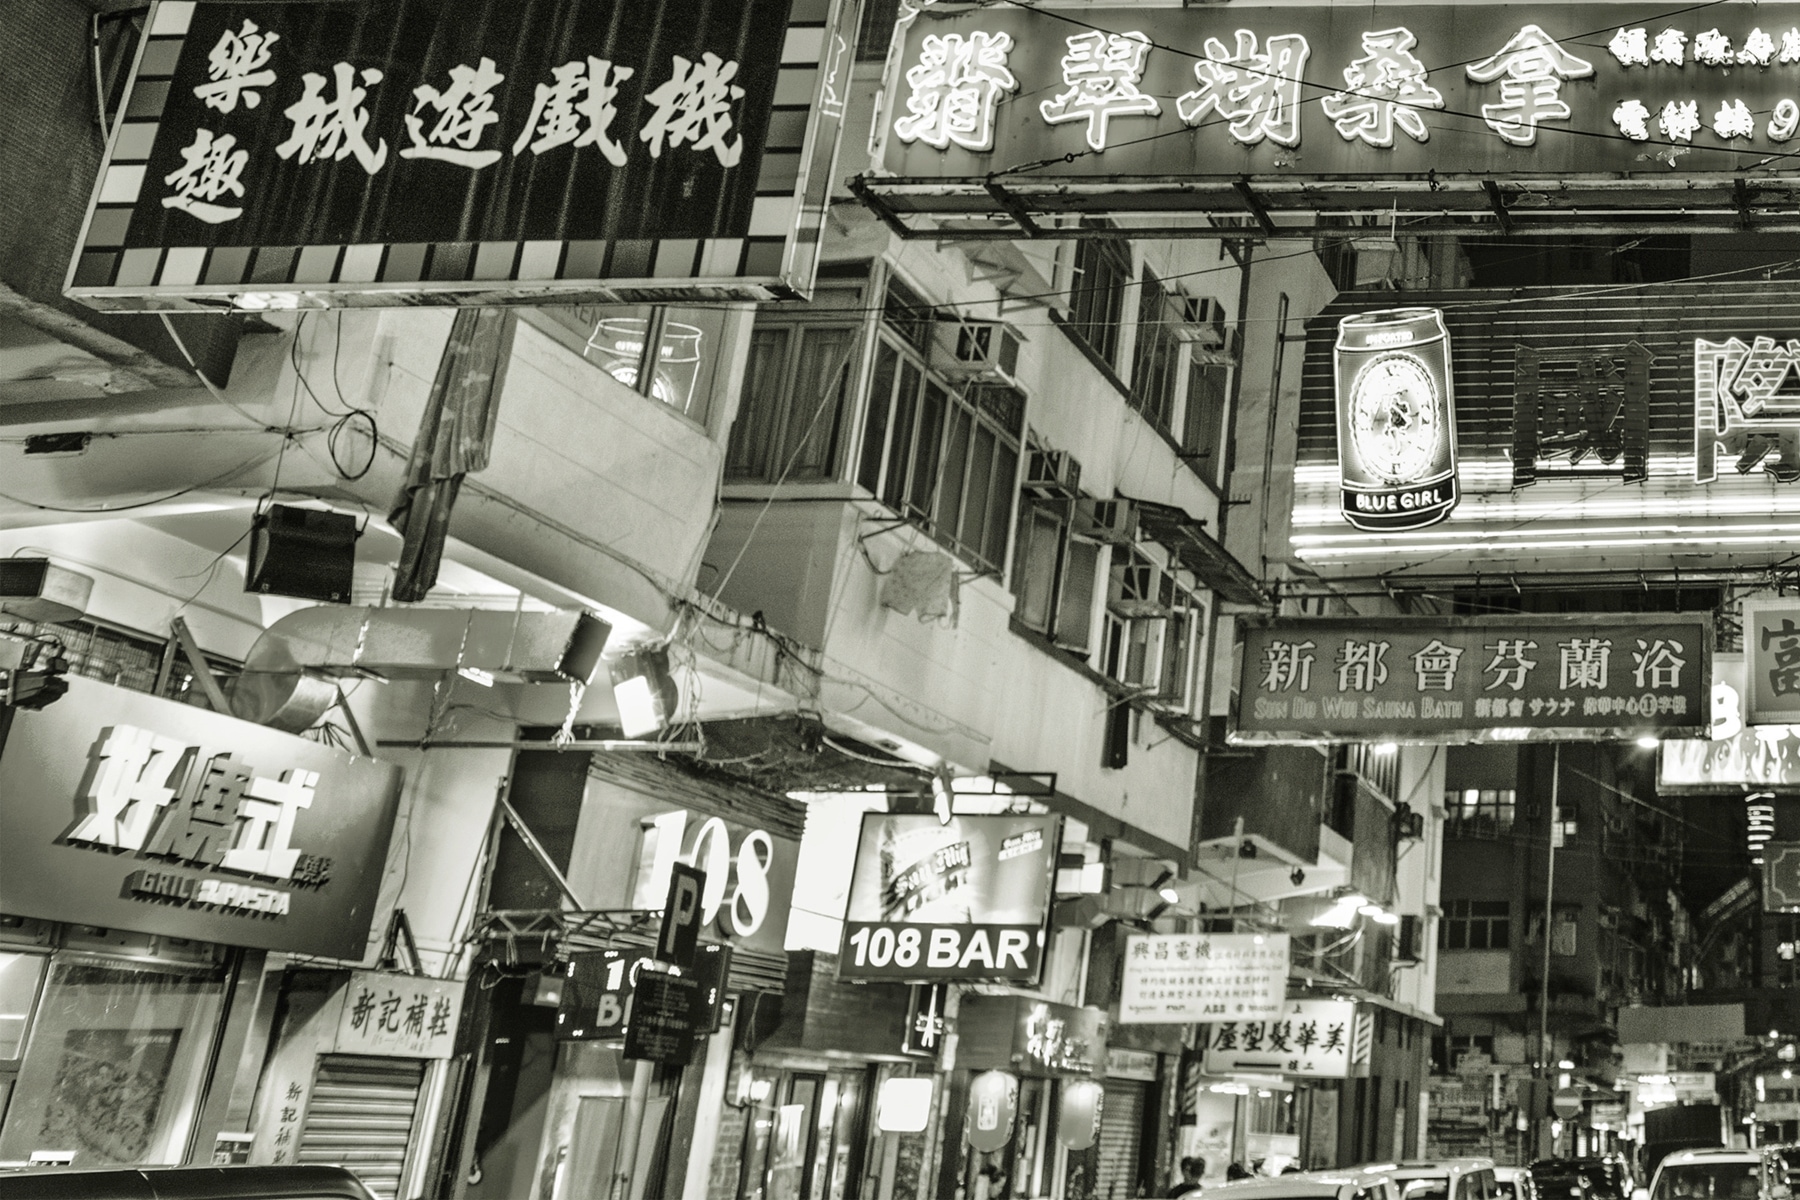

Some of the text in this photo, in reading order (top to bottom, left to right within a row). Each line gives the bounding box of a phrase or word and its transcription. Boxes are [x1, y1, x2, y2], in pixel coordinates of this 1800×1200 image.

[893, 23, 1596, 153] 翡翠湖桑拿
[1355, 488, 1442, 511] BLUE GIRL
[1259, 638, 1687, 693] 新都會芬蘭浴
[665, 874, 699, 954] P
[849, 926, 1030, 970] 108 BAR
